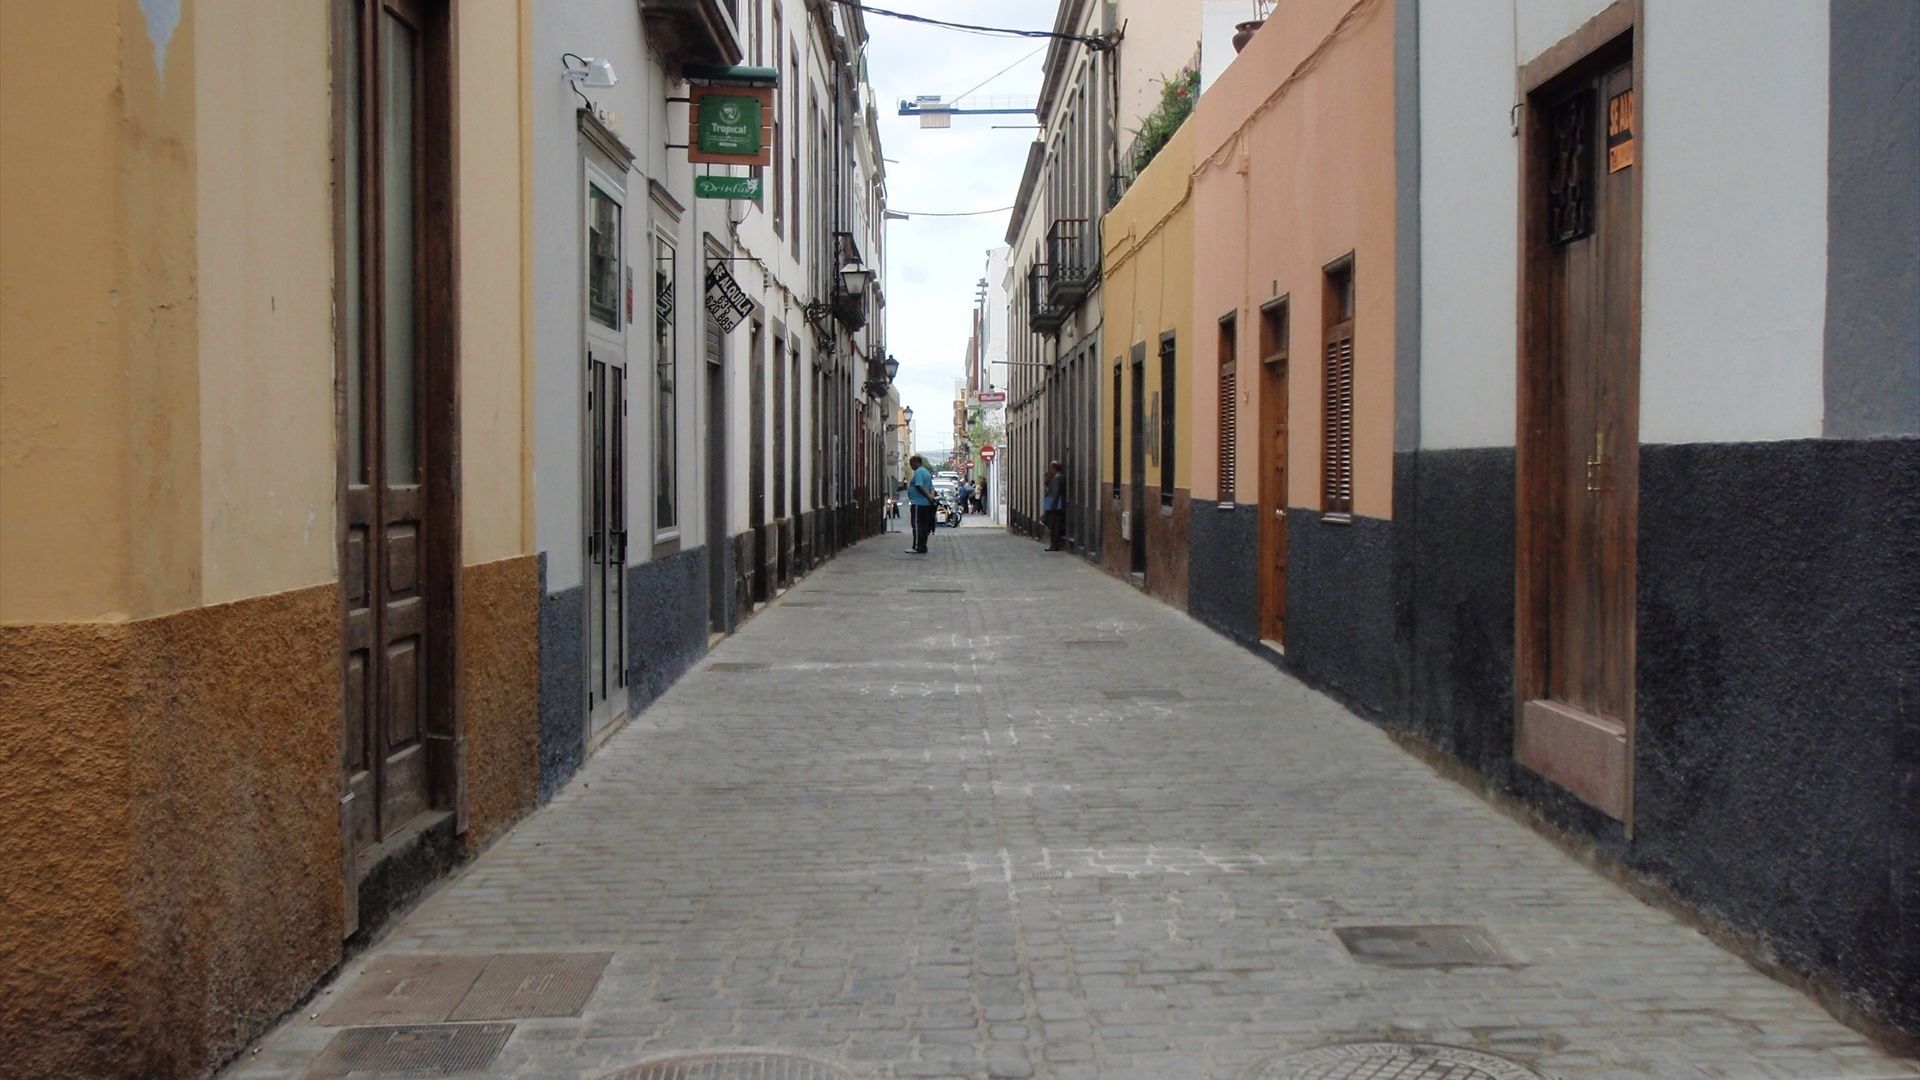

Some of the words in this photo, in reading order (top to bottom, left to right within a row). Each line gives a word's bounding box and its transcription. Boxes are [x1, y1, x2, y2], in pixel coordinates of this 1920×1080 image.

[712, 122, 747, 135] Tropical
[713, 265, 725, 280] SE
[719, 276, 752, 316] ALQUILA
[705, 295, 720, 314] 620
[718, 313, 734, 331] 885
[717, 296, 731, 315] 635
